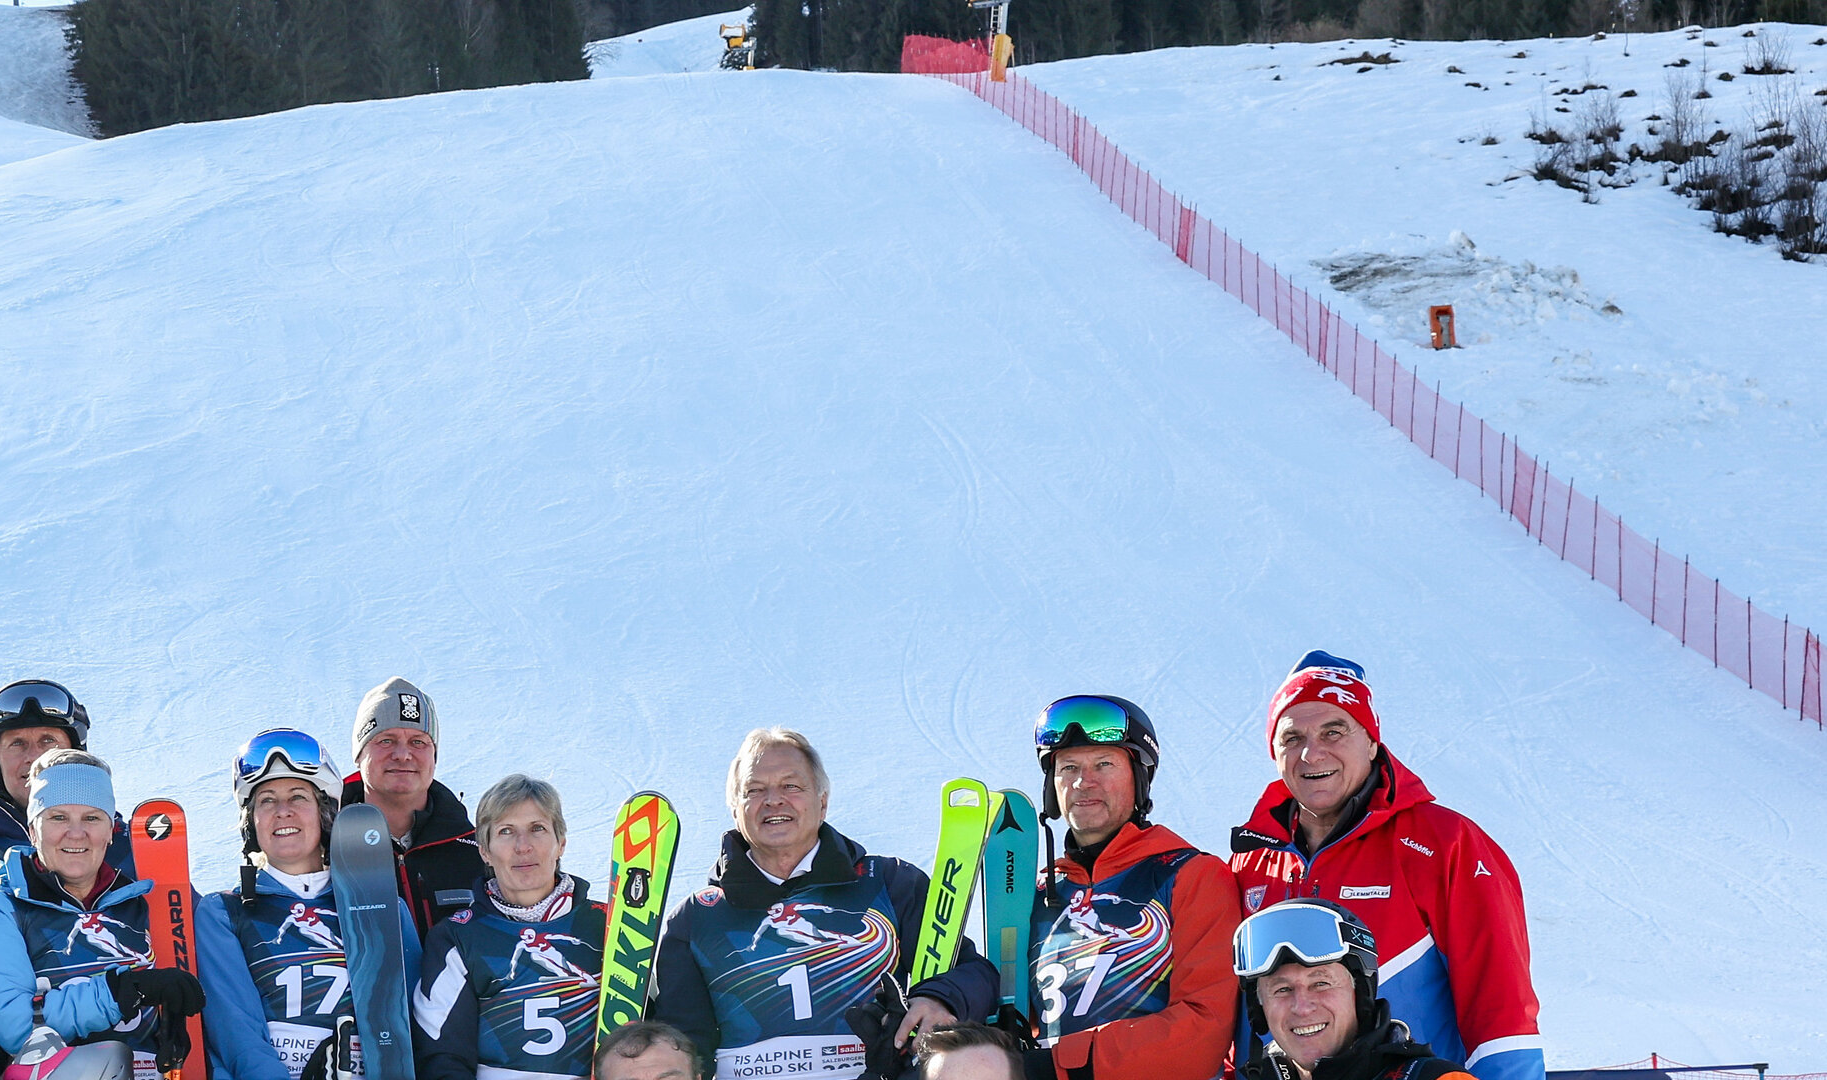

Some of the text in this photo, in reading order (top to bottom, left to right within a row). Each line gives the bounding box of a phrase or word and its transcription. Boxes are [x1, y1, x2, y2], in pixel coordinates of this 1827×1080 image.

[1006, 850, 1015, 895] ATOMIC
[1408, 840, 1434, 857] Schöffel
[168, 889, 189, 971] ZZARD
[275, 965, 349, 1019] 17
[777, 964, 813, 1021] 1
[1036, 953, 1118, 1024] 37
[521, 996, 567, 1056] 5
[733, 1063, 783, 1078] WORLD
[788, 1062, 813, 1073] SKI
[734, 1049, 813, 1065] FIS ALPINE
